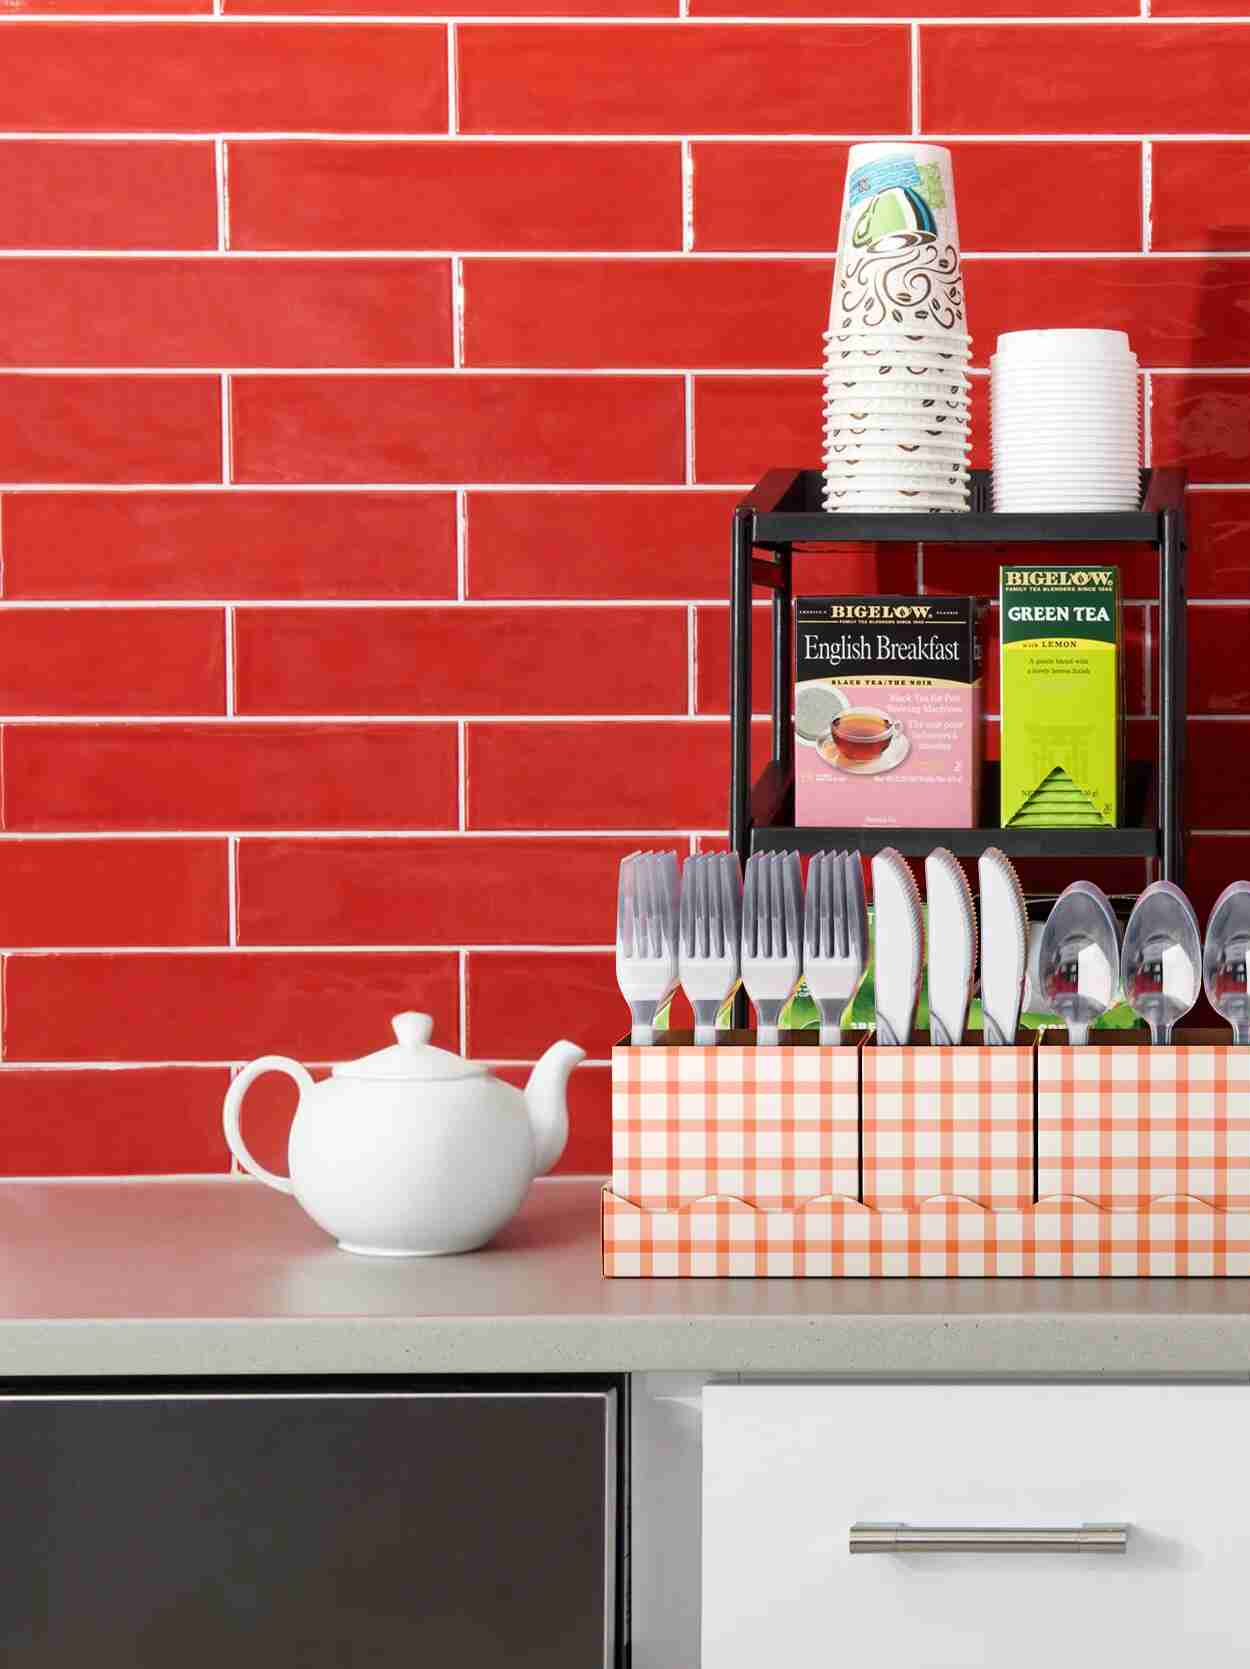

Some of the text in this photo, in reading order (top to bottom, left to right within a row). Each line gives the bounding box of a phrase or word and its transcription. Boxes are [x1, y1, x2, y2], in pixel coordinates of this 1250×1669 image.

[1006, 571, 1112, 586] BIGELOW
[831, 605, 931, 618] BIGELOW
[1008, 606, 1110, 622] GREEN TEA
[804, 634, 871, 666] English
[876, 634, 960, 661] Breakfast
